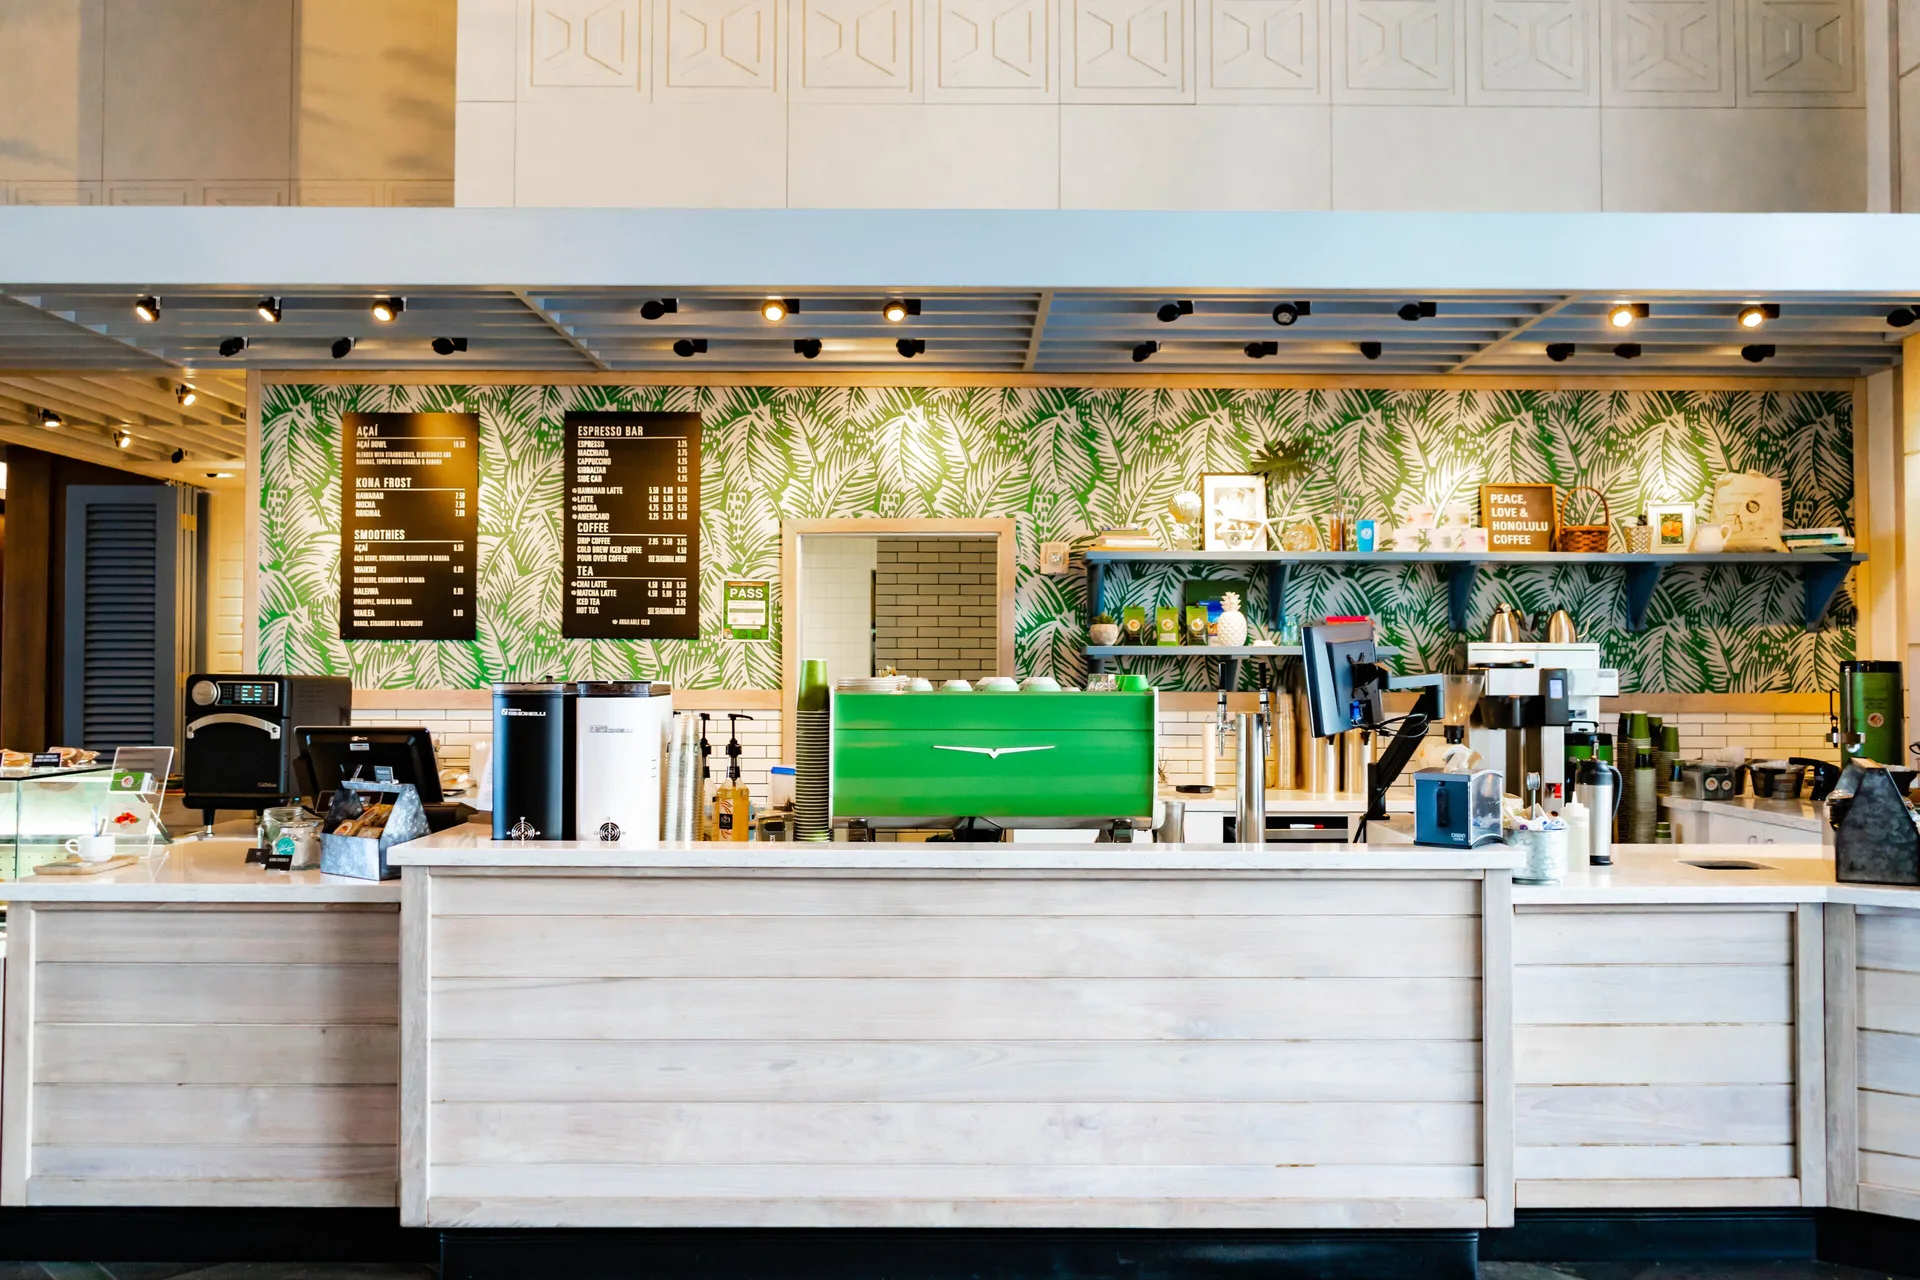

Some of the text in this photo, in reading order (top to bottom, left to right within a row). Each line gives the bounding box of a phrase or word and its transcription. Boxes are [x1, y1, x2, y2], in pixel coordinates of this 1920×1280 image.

[356, 424, 378, 438] AÇAÍ
[578, 426, 643, 436] ESPRESSO BAR
[356, 440, 370, 449] AÇAÍ
[356, 478, 411, 488] KONA FROST
[1490, 494, 1527, 505] PEACE,
[1492, 508, 1528, 517] LOVE &
[577, 523, 609, 532] COFFEE
[1492, 521, 1548, 531] HONOLULU
[354, 530, 405, 539] SMOOTHIES
[1494, 535, 1531, 544] COFFEE
[354, 543, 368, 552] AÇAÍ
[577, 566, 593, 576] TEA
[730, 589, 763, 598] PASS
